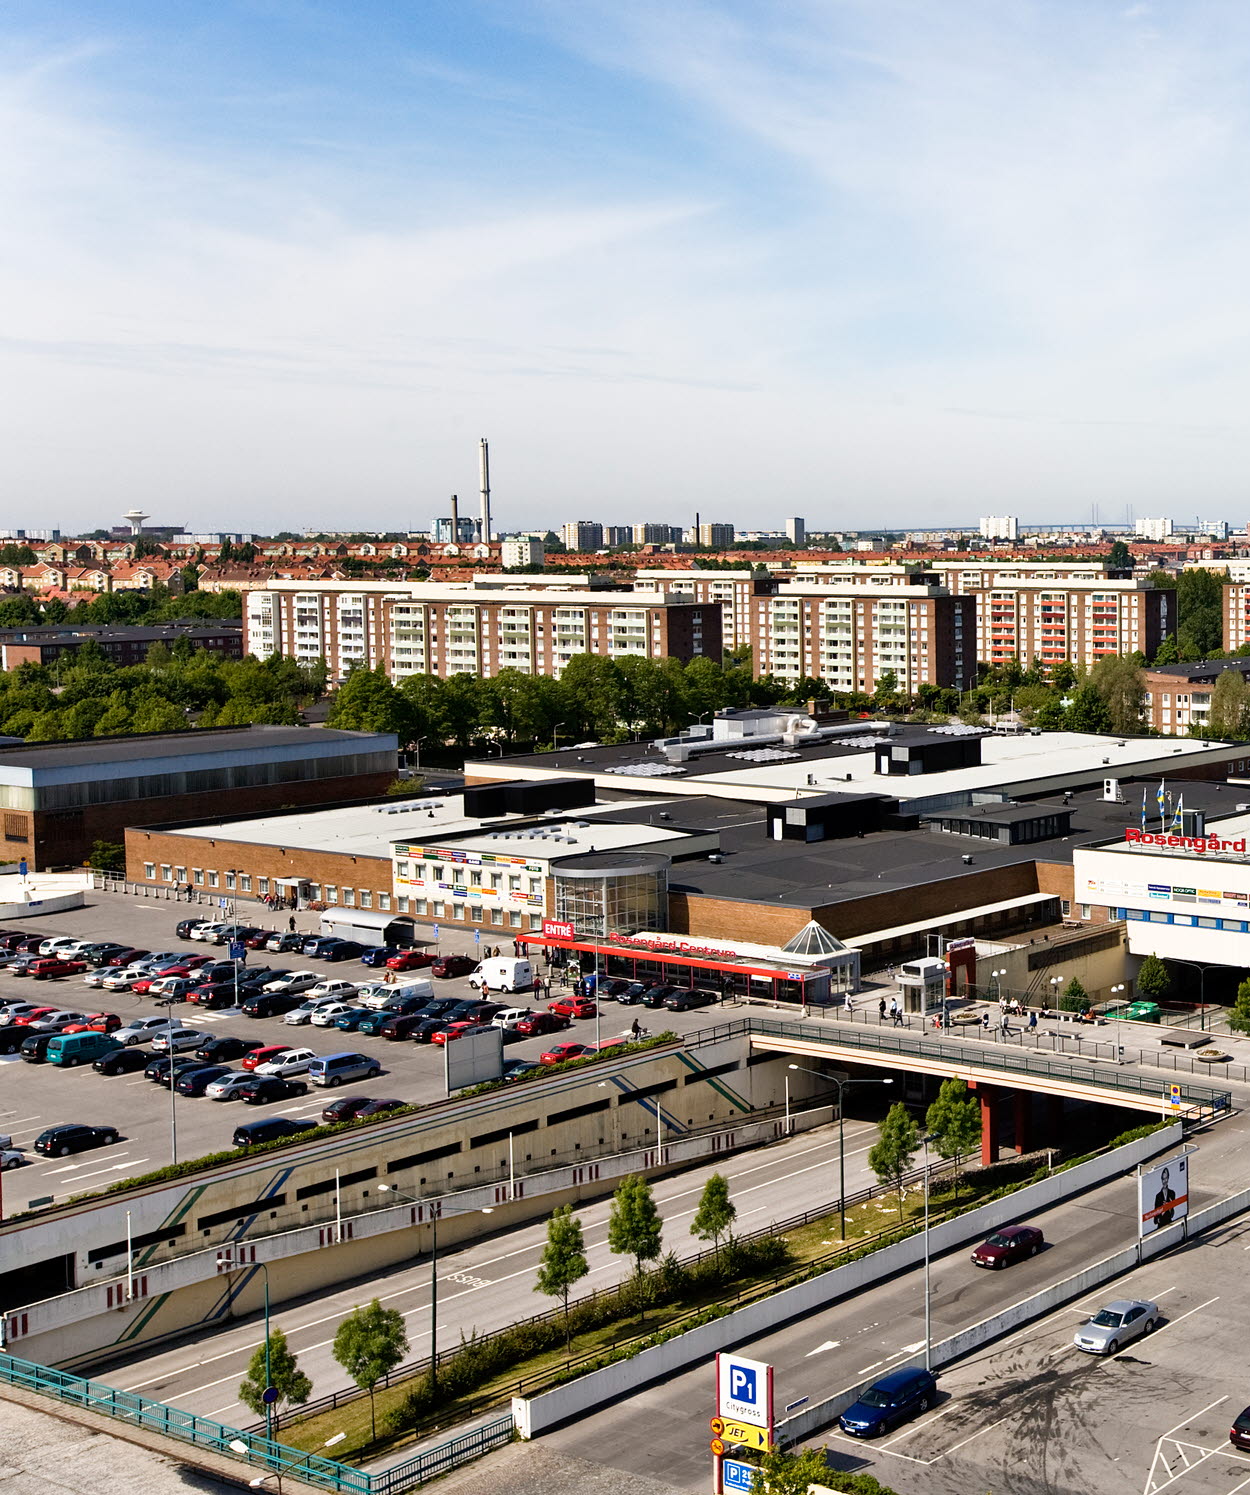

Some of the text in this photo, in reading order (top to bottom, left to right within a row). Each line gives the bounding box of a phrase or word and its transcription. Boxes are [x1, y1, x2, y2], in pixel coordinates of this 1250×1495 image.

[1126, 828, 1246, 854] Rosengård
[545, 924, 572, 936] ENTRÉ
[610, 932, 737, 958] Rosengård Centrum
[732, 1369, 752, 1399] P1
[726, 1402, 760, 1417] Citygross
[729, 1428, 745, 1438] JET
[730, 1468, 738, 1478] P
